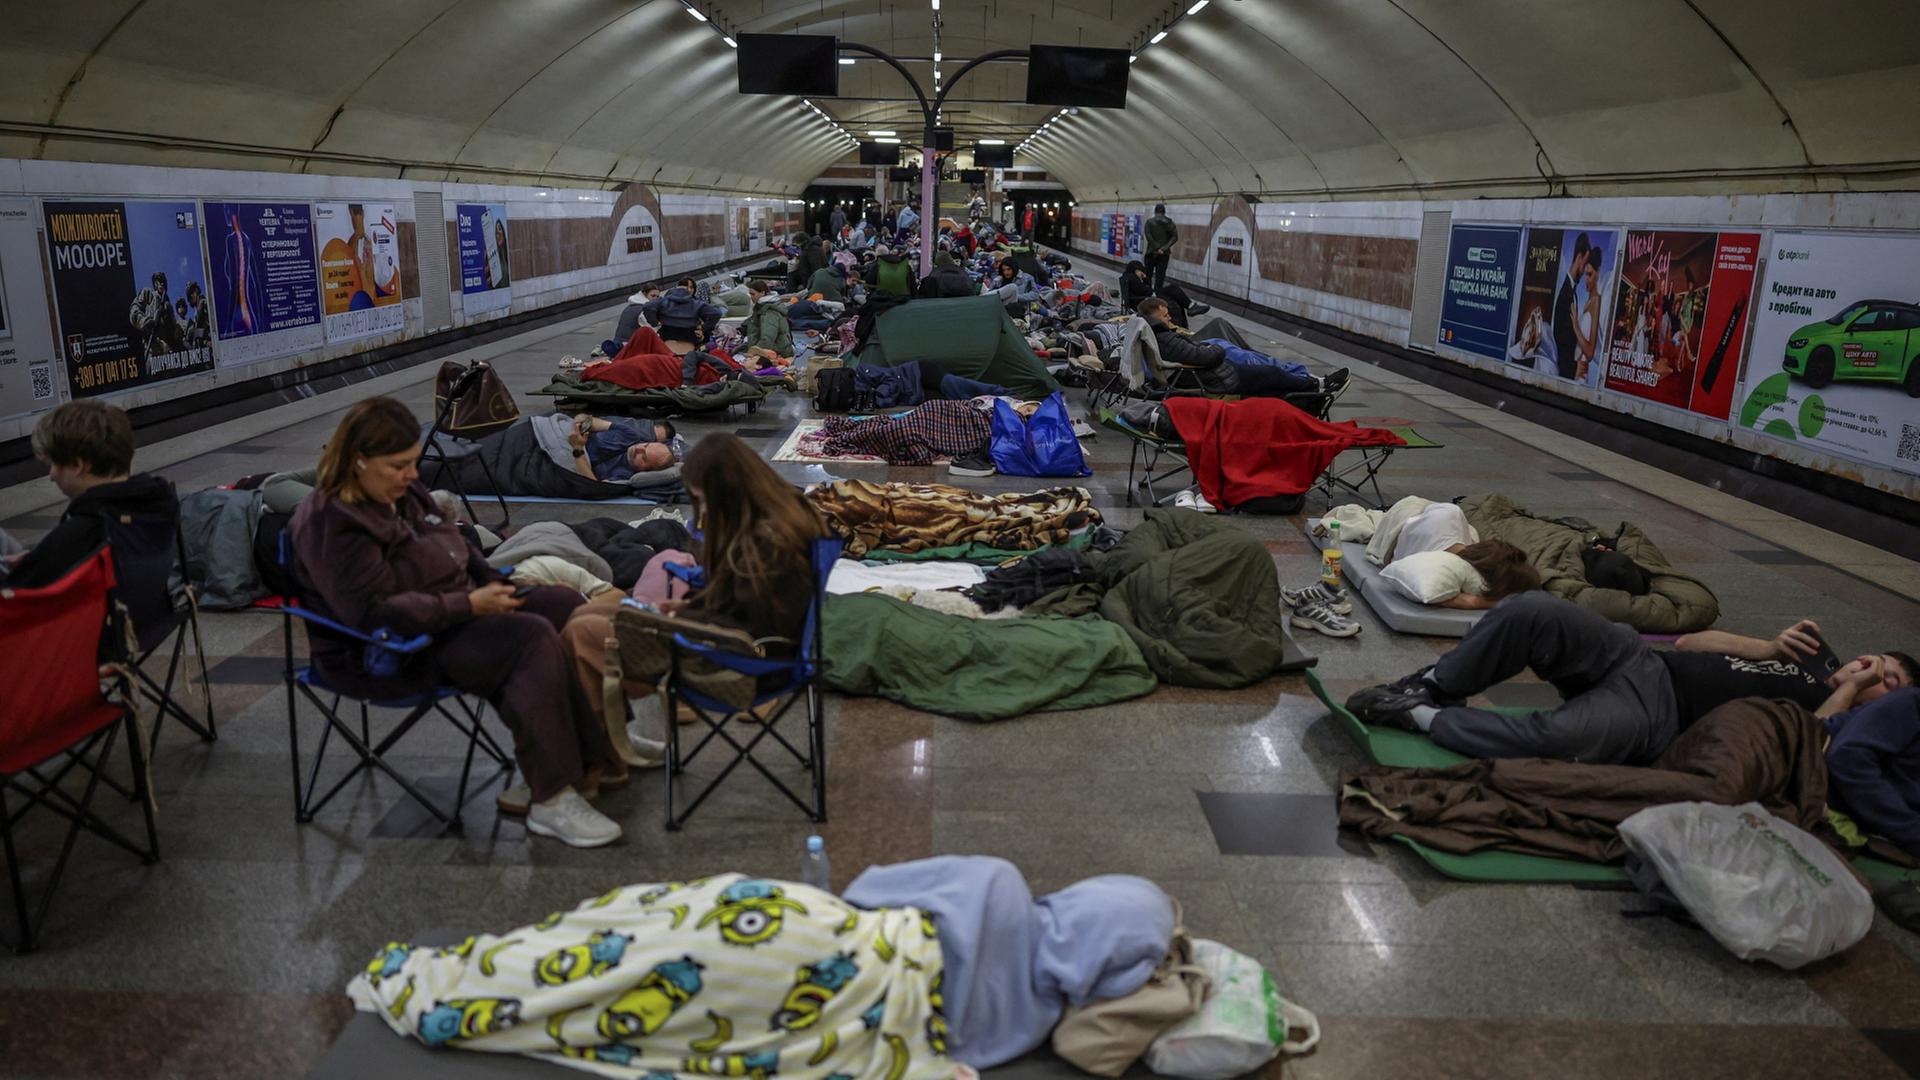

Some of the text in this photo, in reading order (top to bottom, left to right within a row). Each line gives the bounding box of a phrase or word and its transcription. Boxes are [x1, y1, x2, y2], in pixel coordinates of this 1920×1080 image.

[51, 209, 123, 242] МОЖЛИВОСТЕЙ
[56, 243, 126, 270] МОООРЕ
[1628, 232, 1655, 264] Mary
[1453, 265, 1506, 284] ПЕРША В УКРАЇНІ
[1646, 240, 1671, 296] Kay
[1449, 279, 1479, 297] ПІДПИСКА
[1480, 284, 1489, 297] НА
[1490, 286, 1508, 301] БАНК
[1772, 281, 1836, 300] Кредит на авто
[1768, 301, 1812, 316] з пробігом
[74, 356, 138, 389] +380 97 041 17 55
